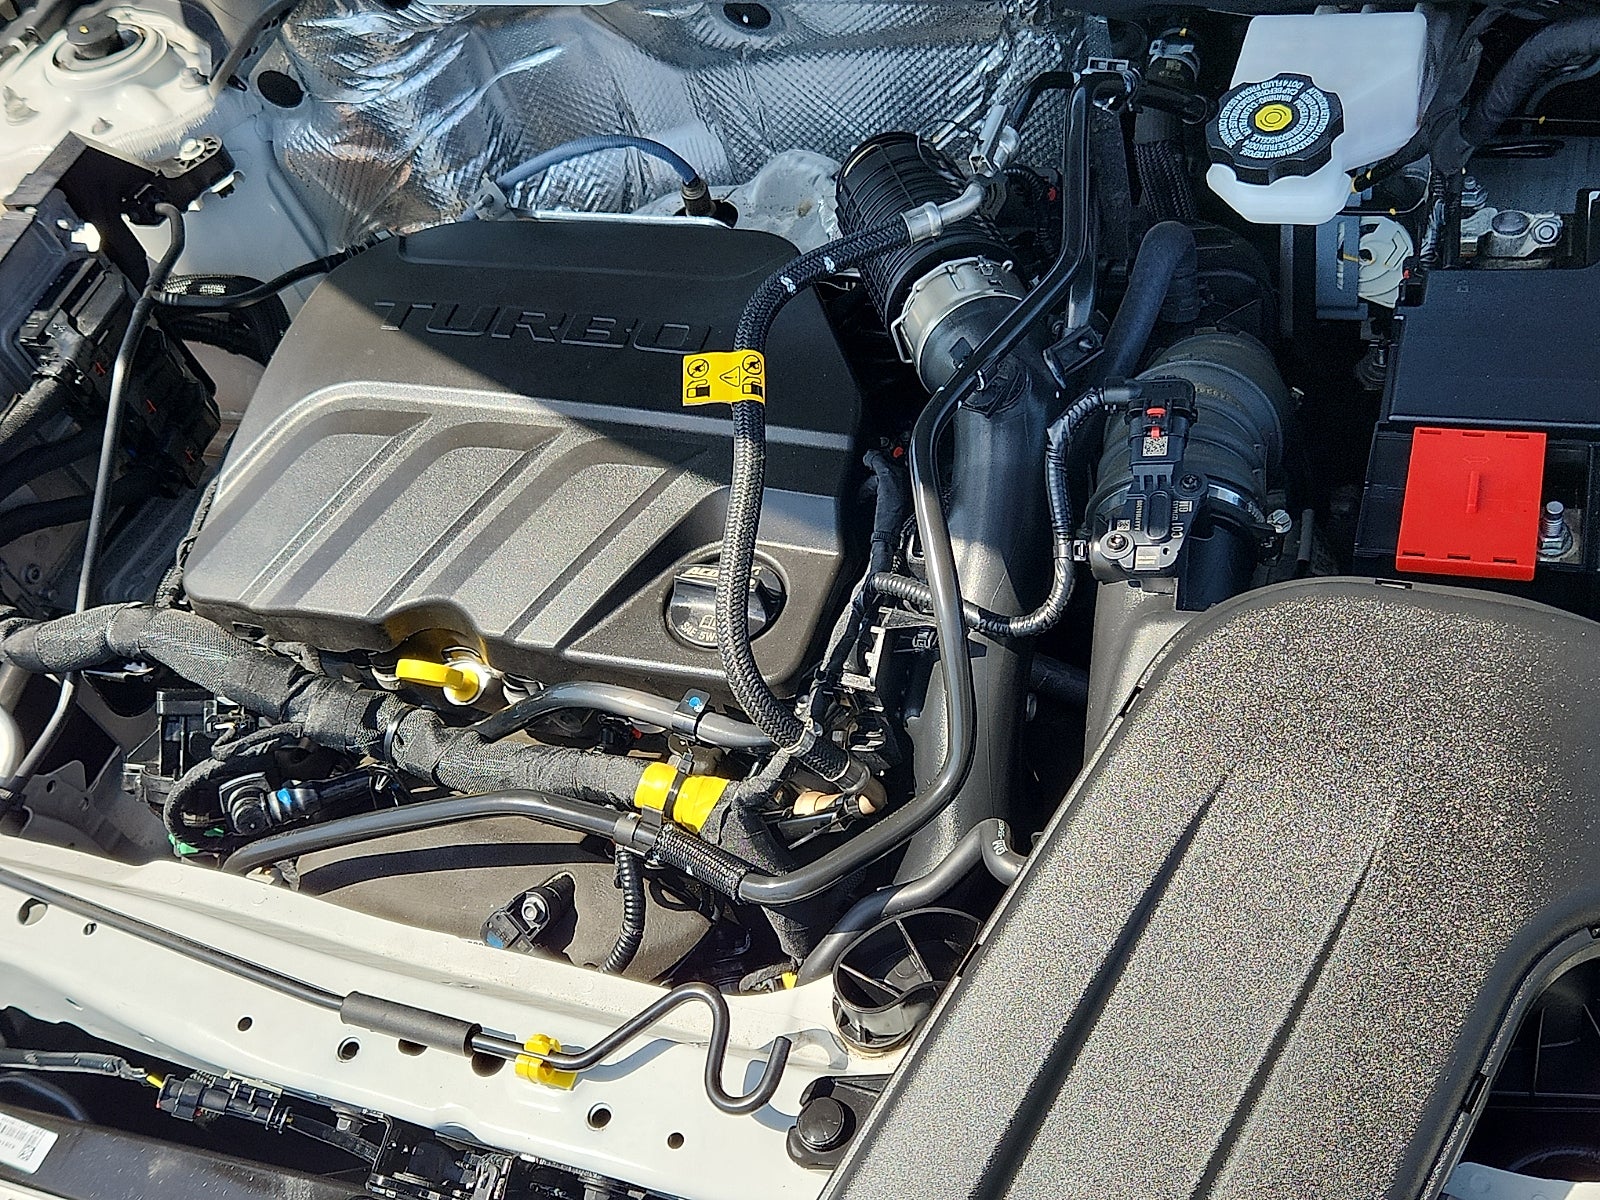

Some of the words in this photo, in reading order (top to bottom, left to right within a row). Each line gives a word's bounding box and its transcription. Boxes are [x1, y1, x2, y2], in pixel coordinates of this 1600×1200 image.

[1240, 85, 1261, 97] FROM
[1262, 80, 1282, 89] FLUID
[1254, 88, 1282, 98] BEFORE
[1240, 102, 1258, 118] CLEAN
[1239, 119, 1251, 136] FILLER
[374, 301, 713, 355] TURBO
[681, 621, 696, 637] SAE
[698, 631, 718, 642] 5W-
